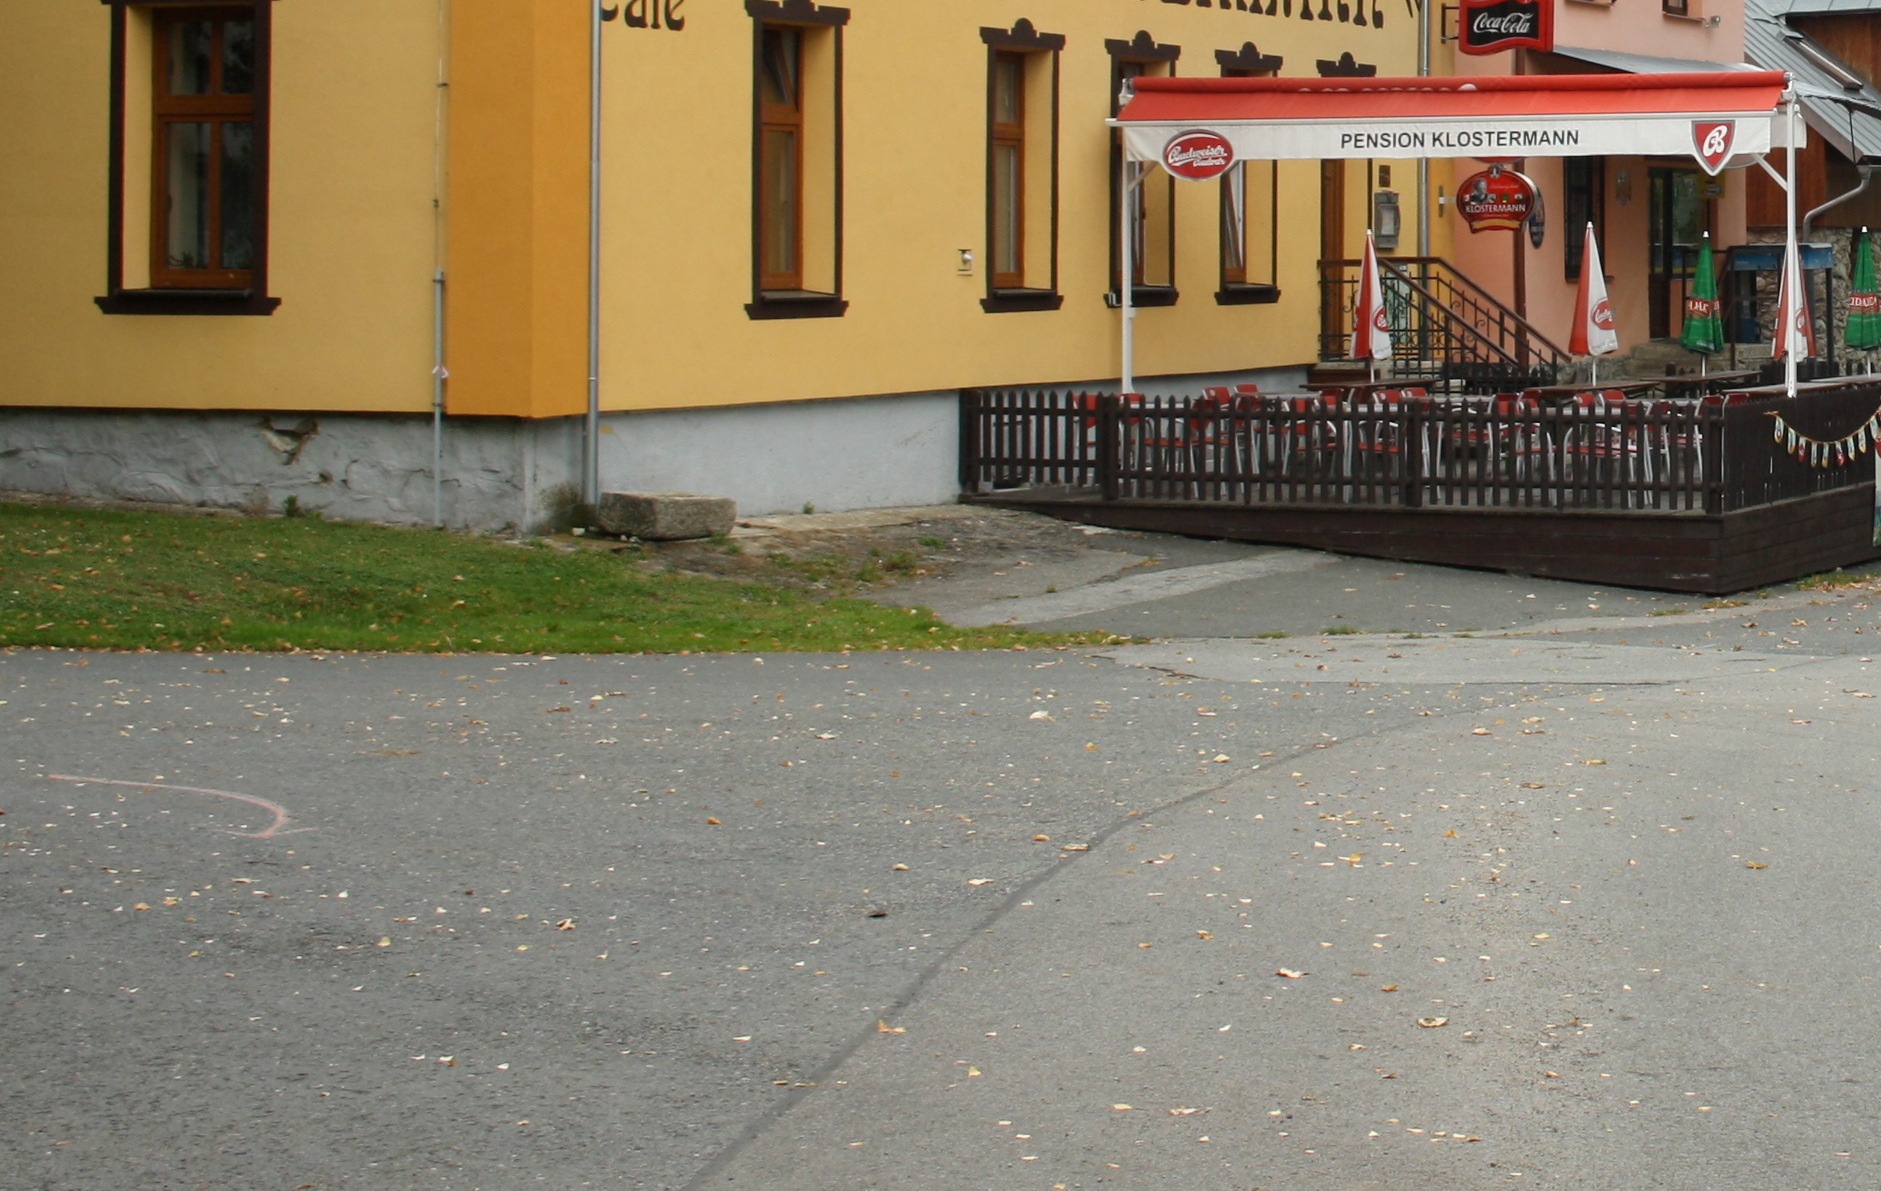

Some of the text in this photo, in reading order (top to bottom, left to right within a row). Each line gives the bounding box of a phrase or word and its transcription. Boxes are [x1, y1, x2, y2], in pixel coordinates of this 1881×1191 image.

[1473, 12, 1534, 34] Coca-Cola
[1341, 130, 1579, 149] PENSION KLOSTERMANN
[1465, 203, 1526, 213] KLOSTERMANN
